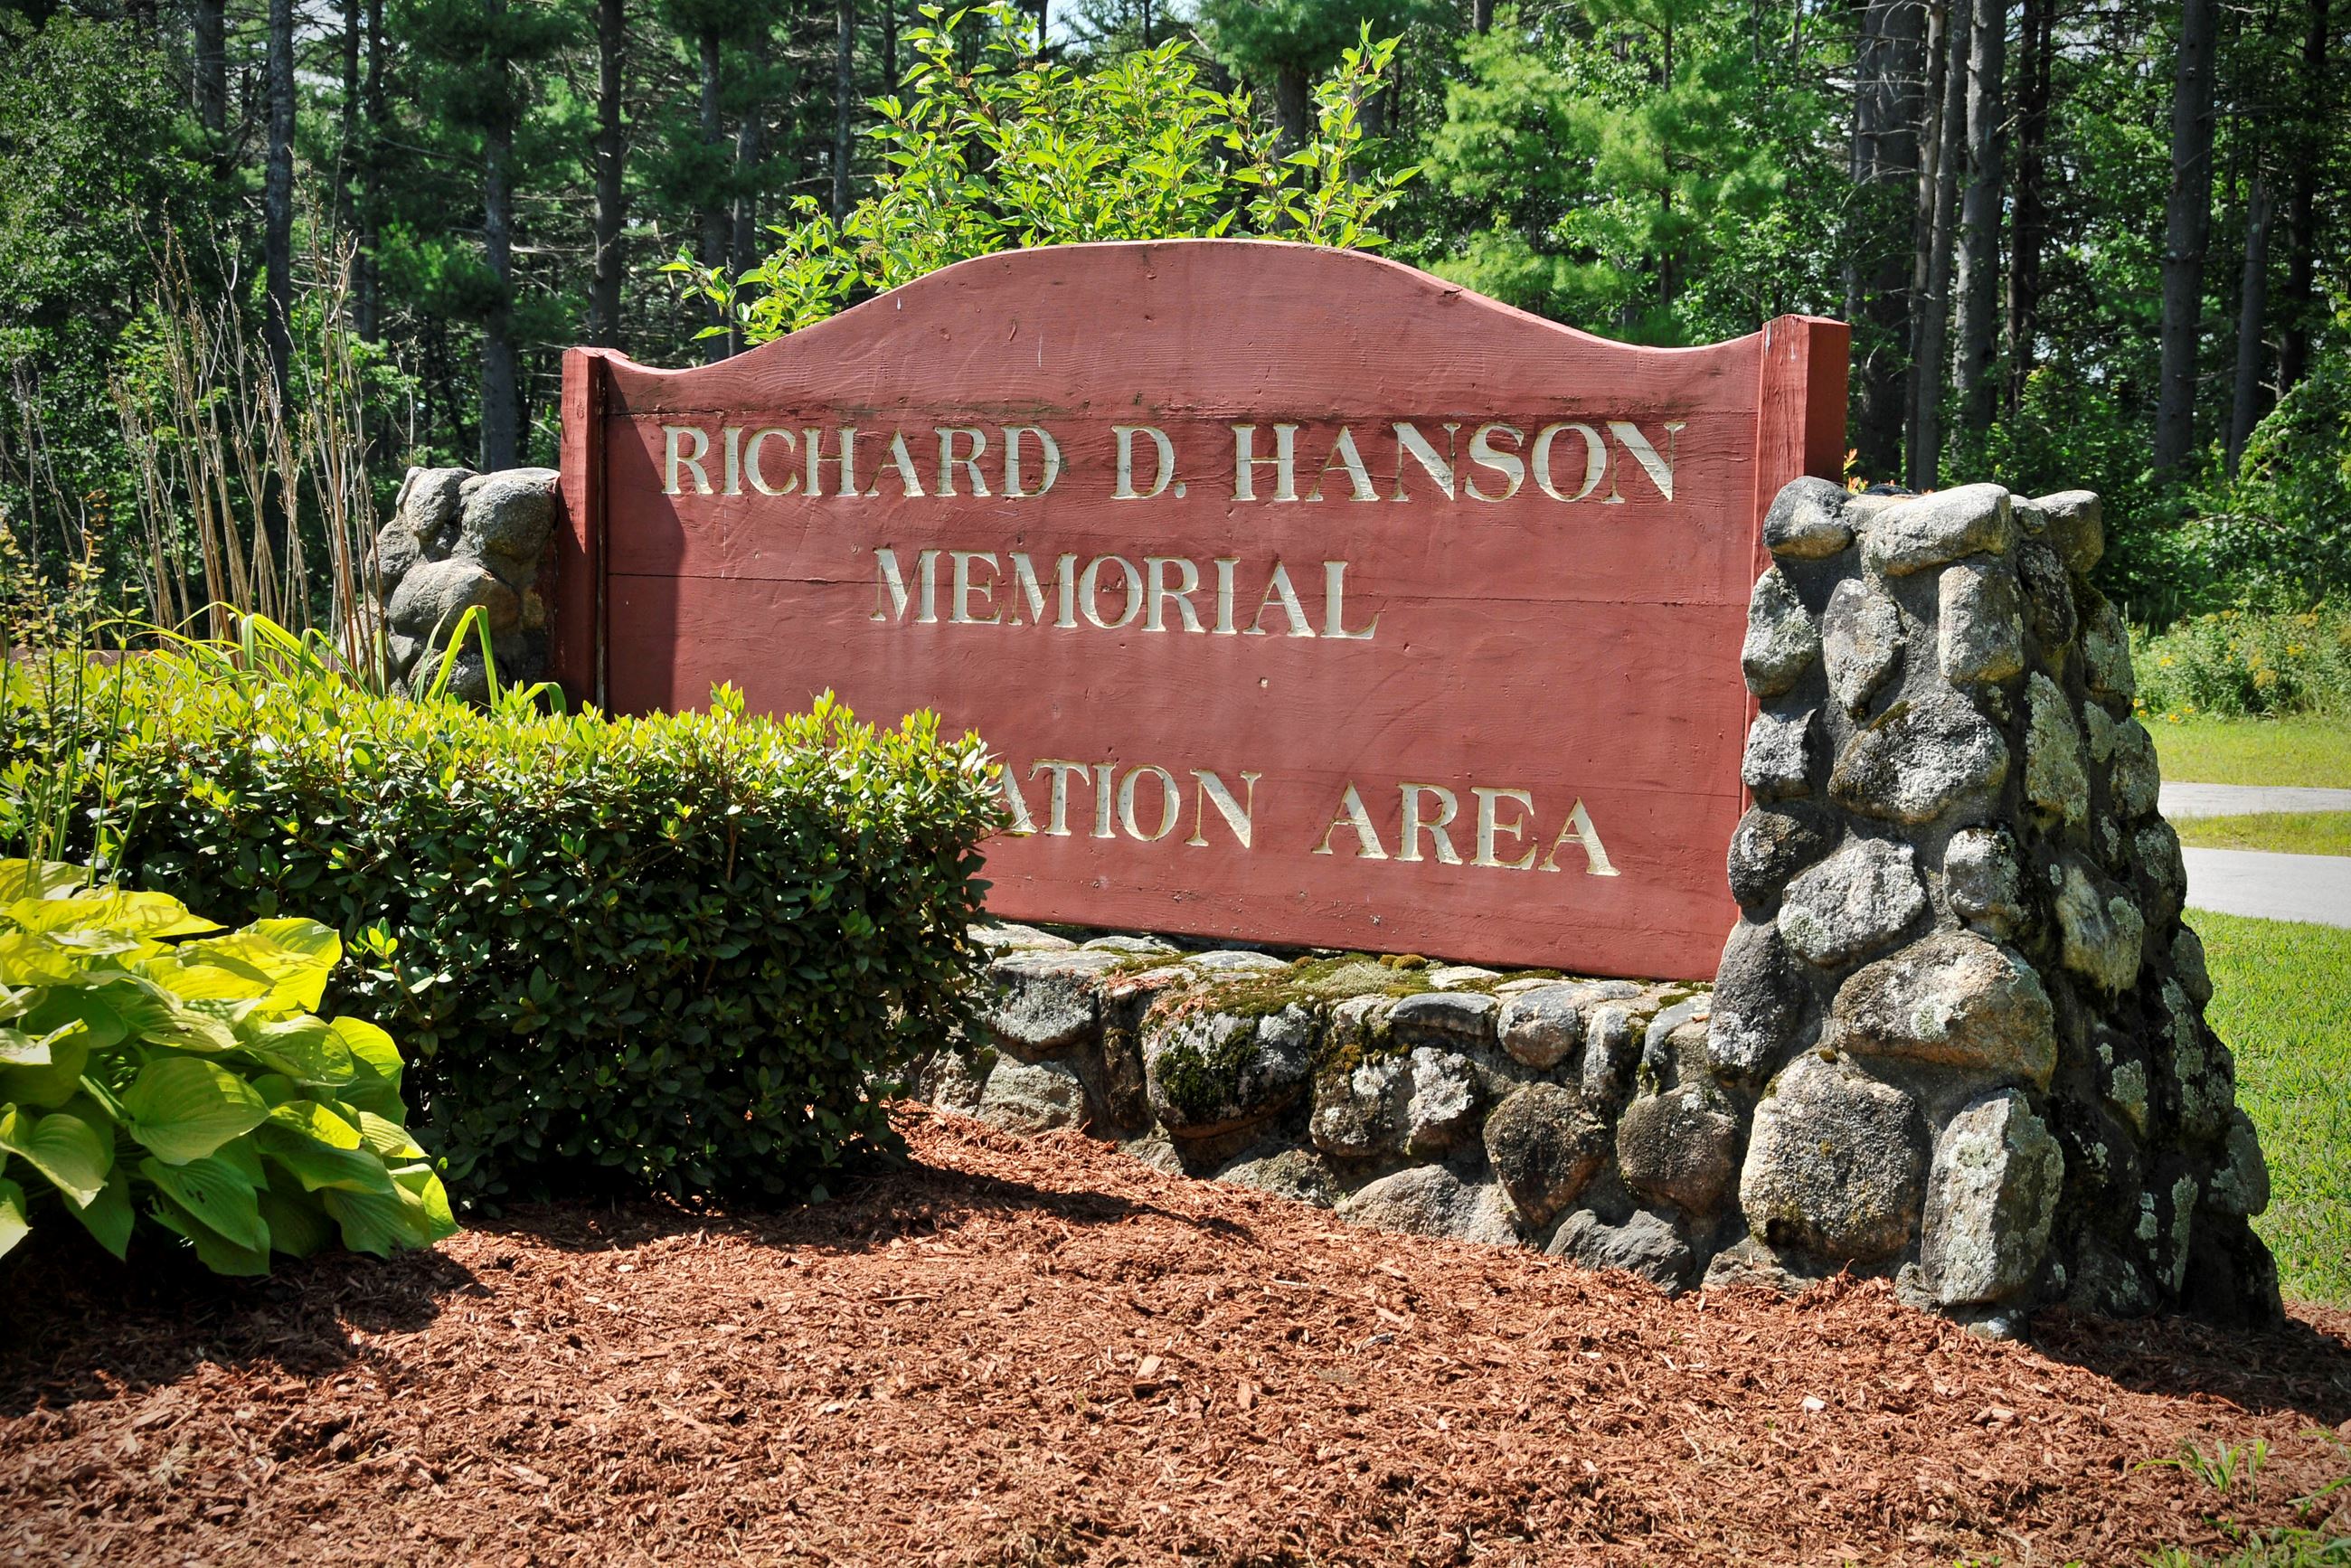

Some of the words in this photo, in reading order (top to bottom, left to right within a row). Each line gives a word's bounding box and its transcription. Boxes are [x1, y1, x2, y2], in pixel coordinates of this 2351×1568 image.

[661, 424, 1060, 498] RICHARD
[1110, 425, 1186, 500] D.
[1230, 420, 1687, 505] HANSON
[868, 547, 1384, 641] MEMORIAL
[990, 757, 1262, 849] ATION
[1311, 780, 1622, 877] AREA
